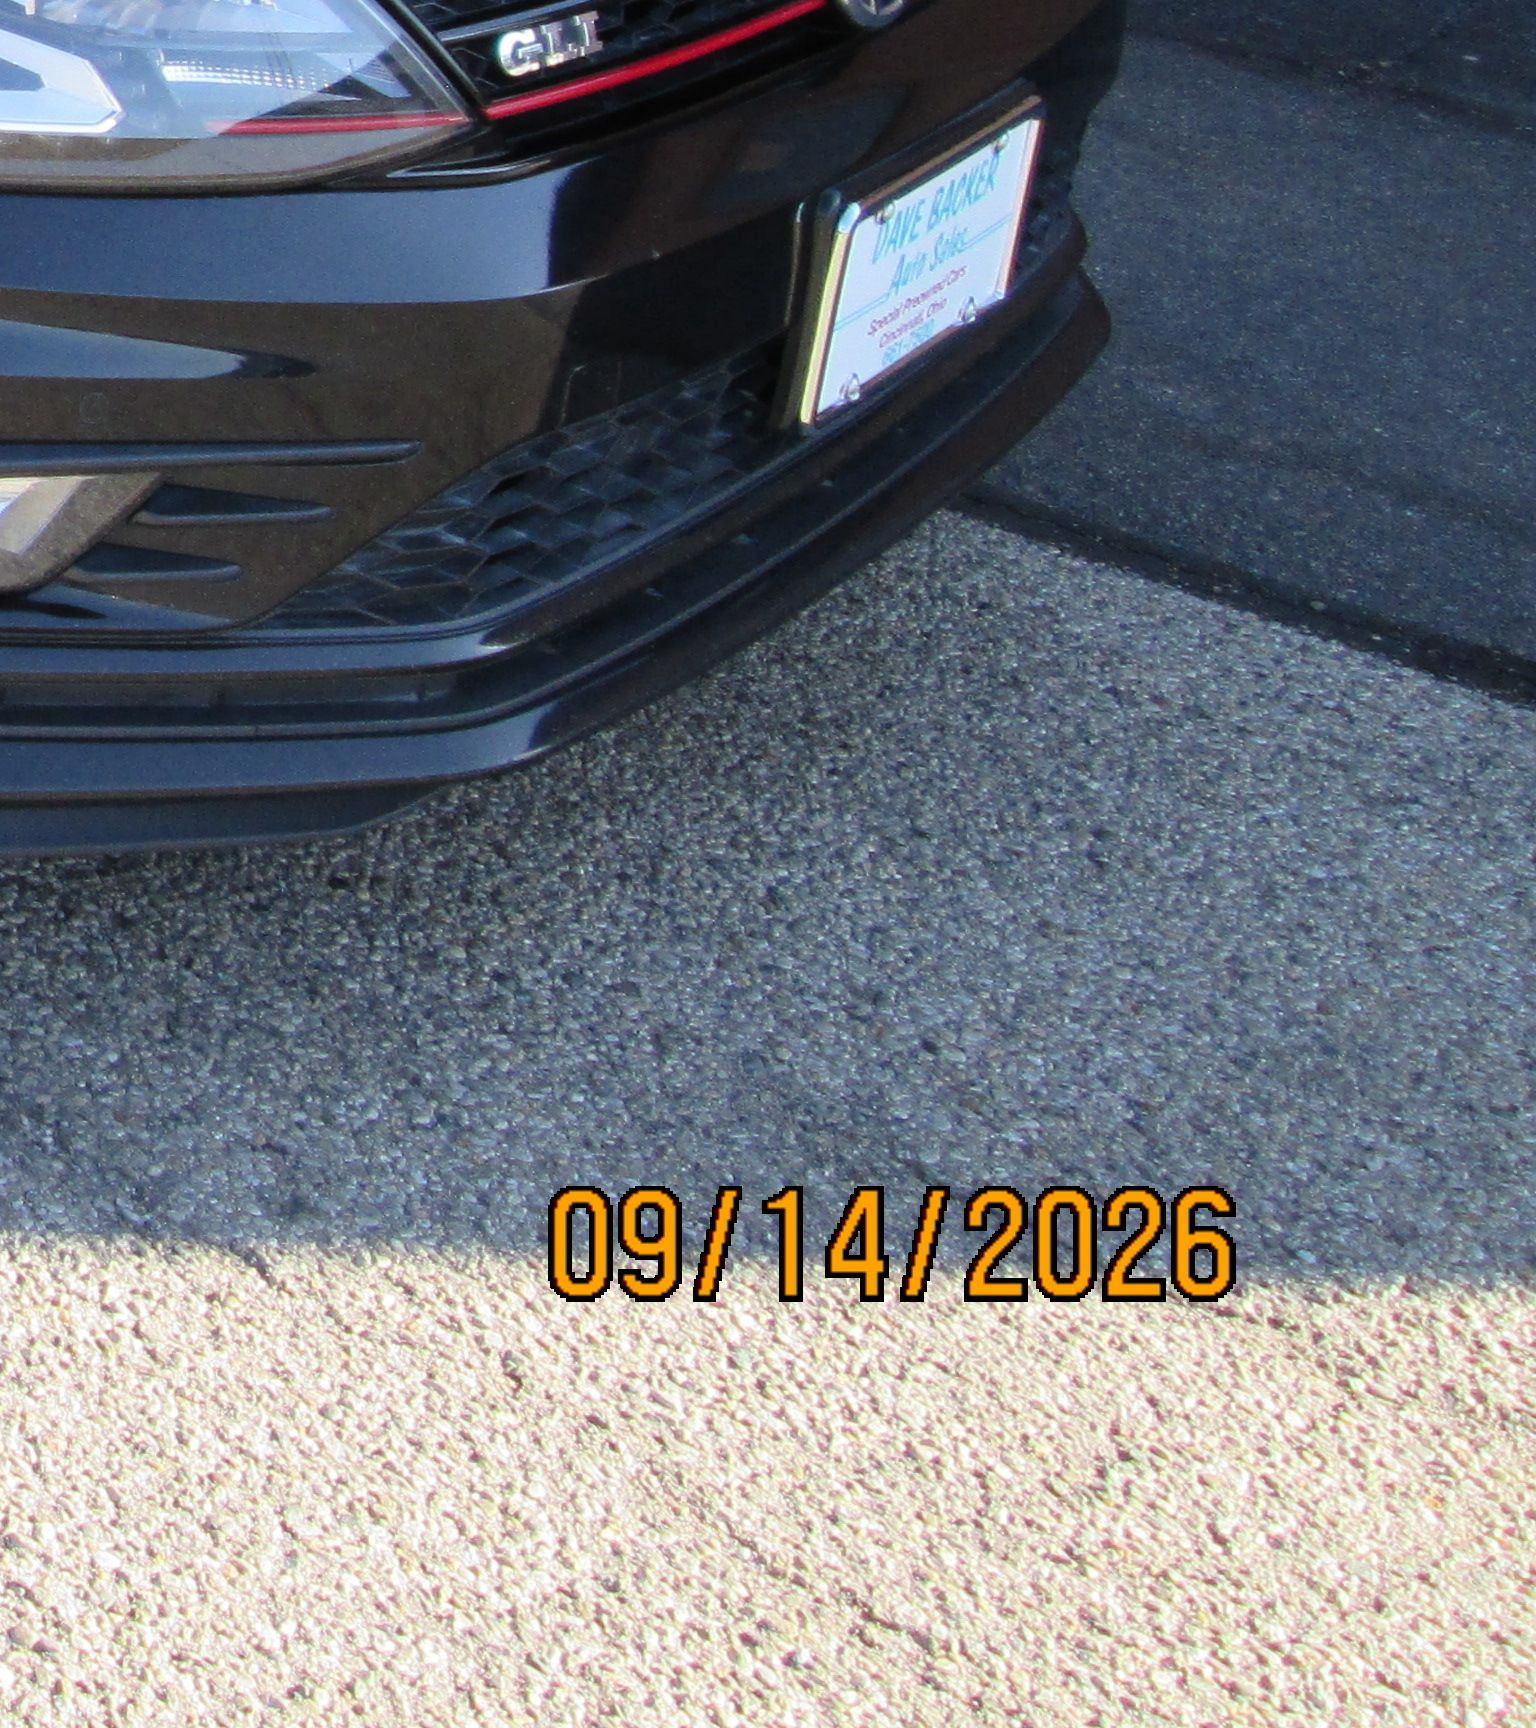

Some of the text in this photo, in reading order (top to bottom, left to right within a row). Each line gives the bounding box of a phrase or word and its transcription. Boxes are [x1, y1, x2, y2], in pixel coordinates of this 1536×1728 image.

[496, 9, 603, 77] GLI
[871, 152, 1000, 265] DAVE BACKER
[888, 251, 927, 296] Auto
